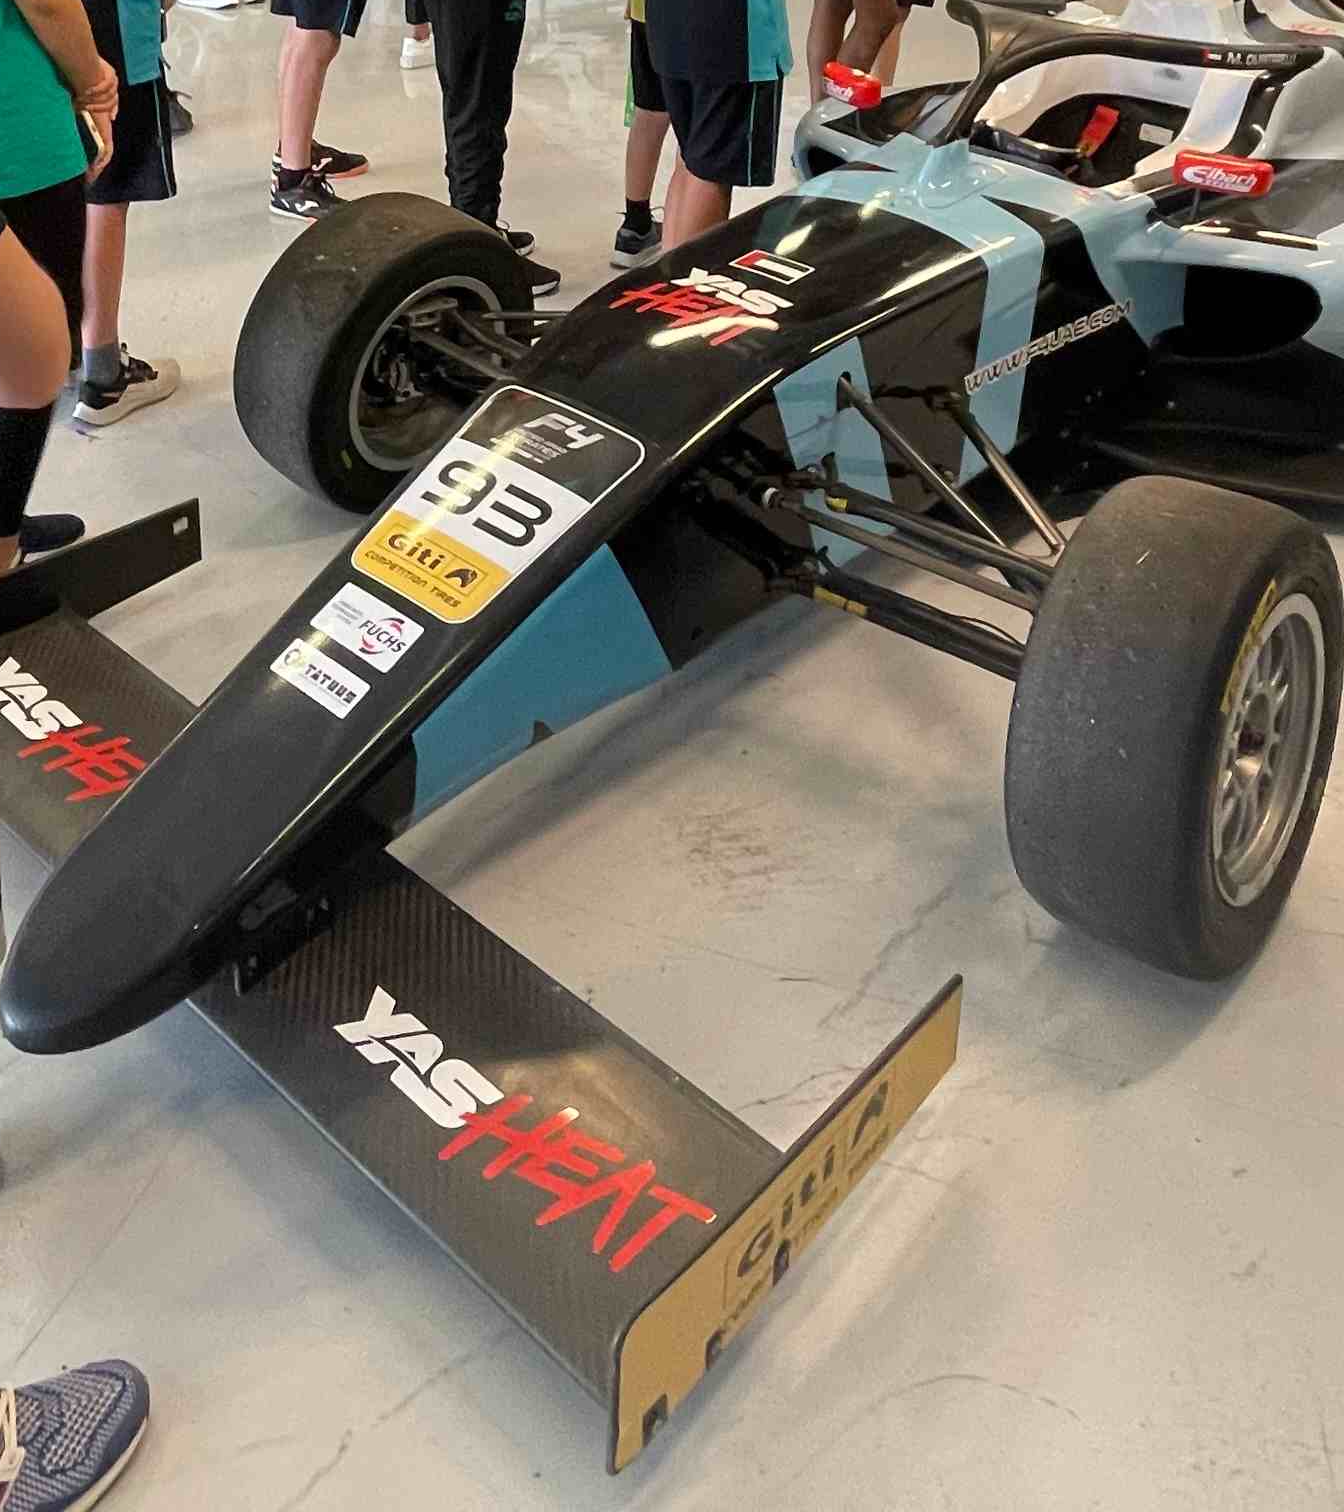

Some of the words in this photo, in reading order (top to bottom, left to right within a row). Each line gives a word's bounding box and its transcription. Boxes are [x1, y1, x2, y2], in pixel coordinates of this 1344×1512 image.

[670, 267, 794, 316] YAS
[523, 412, 605, 450] F4
[420, 460, 553, 547] 93
[388, 532, 445, 570] Giti
[364, 549, 429, 588] COMPETITION
[429, 585, 462, 609] TIRES
[359, 619, 407, 654] FUCHS
[304, 663, 358, 705] TATUUS
[17, 725, 147, 804] HE
[334, 985, 504, 1129] YAS
[436, 1093, 718, 1272] HEAT
[736, 1144, 835, 1278] Giti
